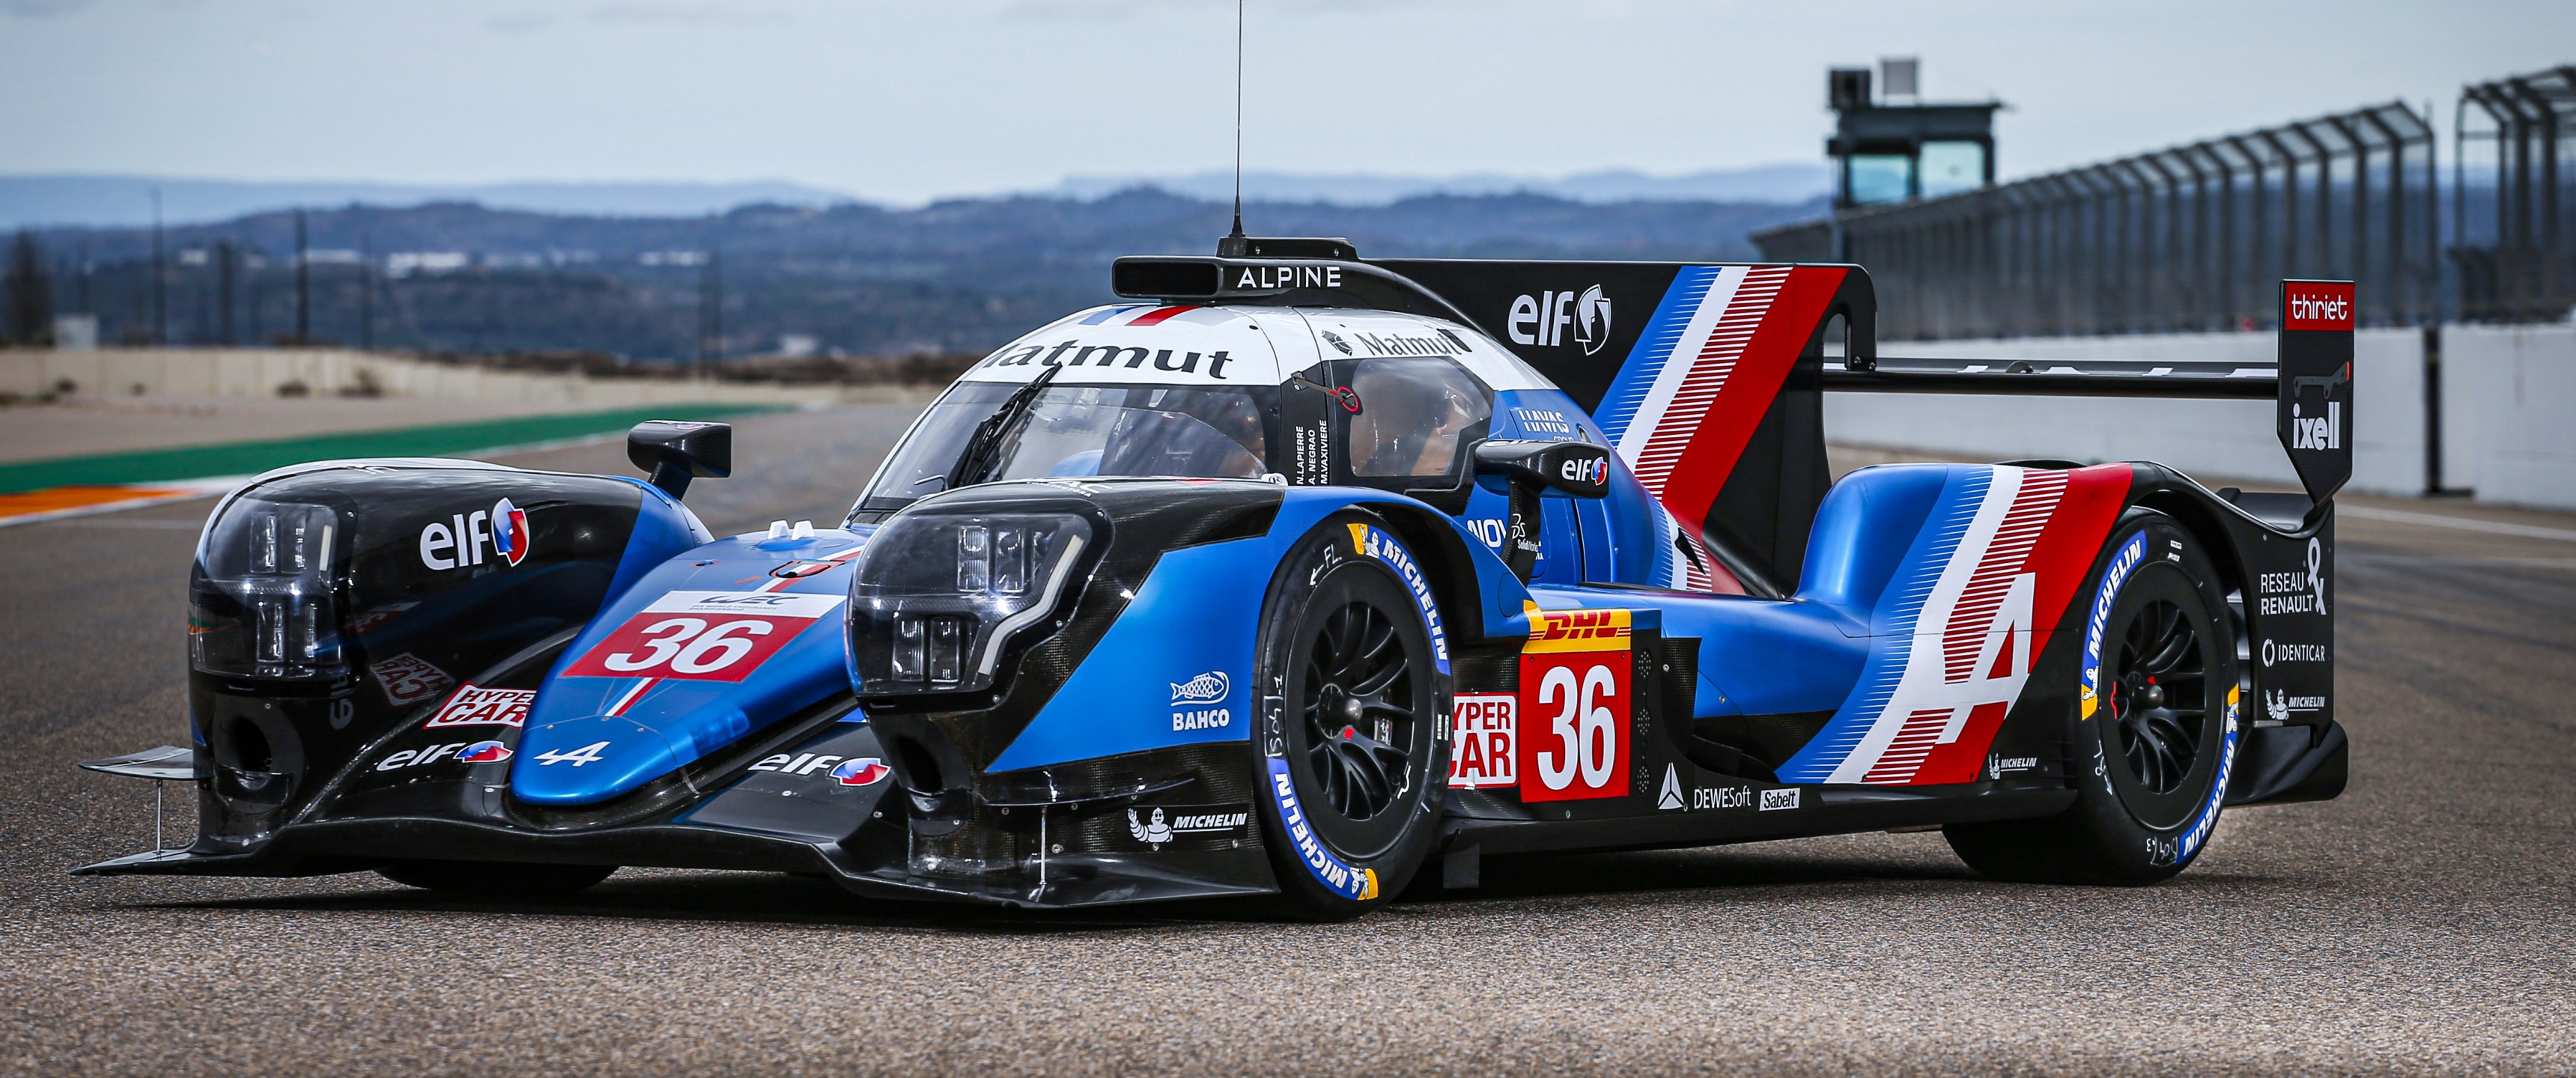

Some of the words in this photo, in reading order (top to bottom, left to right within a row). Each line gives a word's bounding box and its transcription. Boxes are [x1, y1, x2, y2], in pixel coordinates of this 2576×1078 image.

[1237, 267, 1341, 288] ALPINE
[1508, 291, 1574, 346] elf
[2292, 293, 2347, 320] thiriet
[1519, 410, 1570, 433] HAVAS
[2293, 402, 2340, 450] ixell
[1296, 425, 1304, 485] N.LAPIERRE
[1308, 429, 1316, 472] NEGRAO
[1319, 419, 1328, 484] M.VAXIVIERE
[1561, 458, 1591, 481] elf
[420, 510, 488, 570] elf
[2261, 573, 2304, 594] RESEAU
[1382, 538, 1448, 661] MICHELIN
[2088, 539, 2142, 660] MICHELIN
[2261, 594, 2313, 615] RENAULT
[1542, 611, 1617, 640] DHL
[604, 618, 774, 674] 36
[2278, 645, 2325, 663] IDENTICAR
[458, 689, 533, 704] HYPE
[2288, 696, 2325, 708] MICHELIN
[438, 702, 529, 723] CAR
[1173, 708, 1230, 731] BAHCO
[1453, 701, 1510, 732] YPER
[1537, 665, 1617, 791] 36
[377, 743, 467, 771] elf
[748, 752, 842, 776] elf
[2000, 758, 2037, 769] MICHELIN
[1694, 786, 1752, 808] DEWESoft
[1763, 790, 1797, 809] Sabelt
[2183, 738, 2235, 856] MICHELIN
[1173, 812, 1248, 829] MICHELIN
[1275, 772, 1347, 889] MICHELIN
